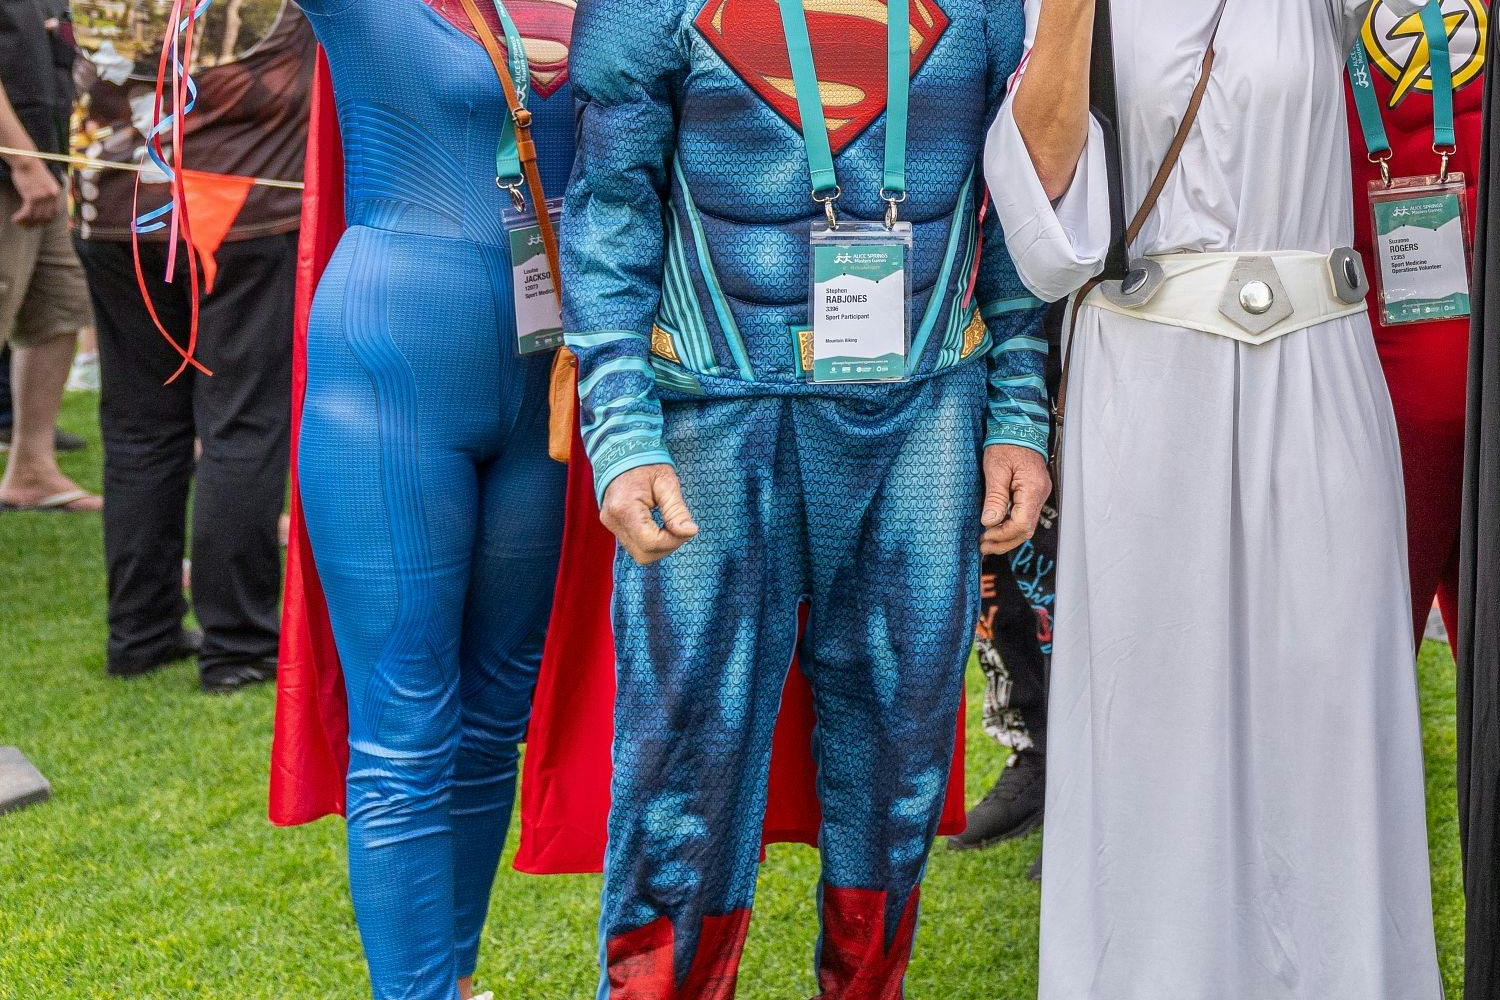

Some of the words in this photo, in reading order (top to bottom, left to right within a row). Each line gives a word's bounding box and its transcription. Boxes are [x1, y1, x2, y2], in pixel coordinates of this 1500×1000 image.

[1389, 243, 1419, 253] ROGERS
[1405, 259, 1427, 267] Medicine
[1392, 266, 1418, 275] Operations
[1419, 263, 1442, 272] Volunteer
[826, 287, 848, 296] Stephen
[826, 294, 868, 304] RABJONES
